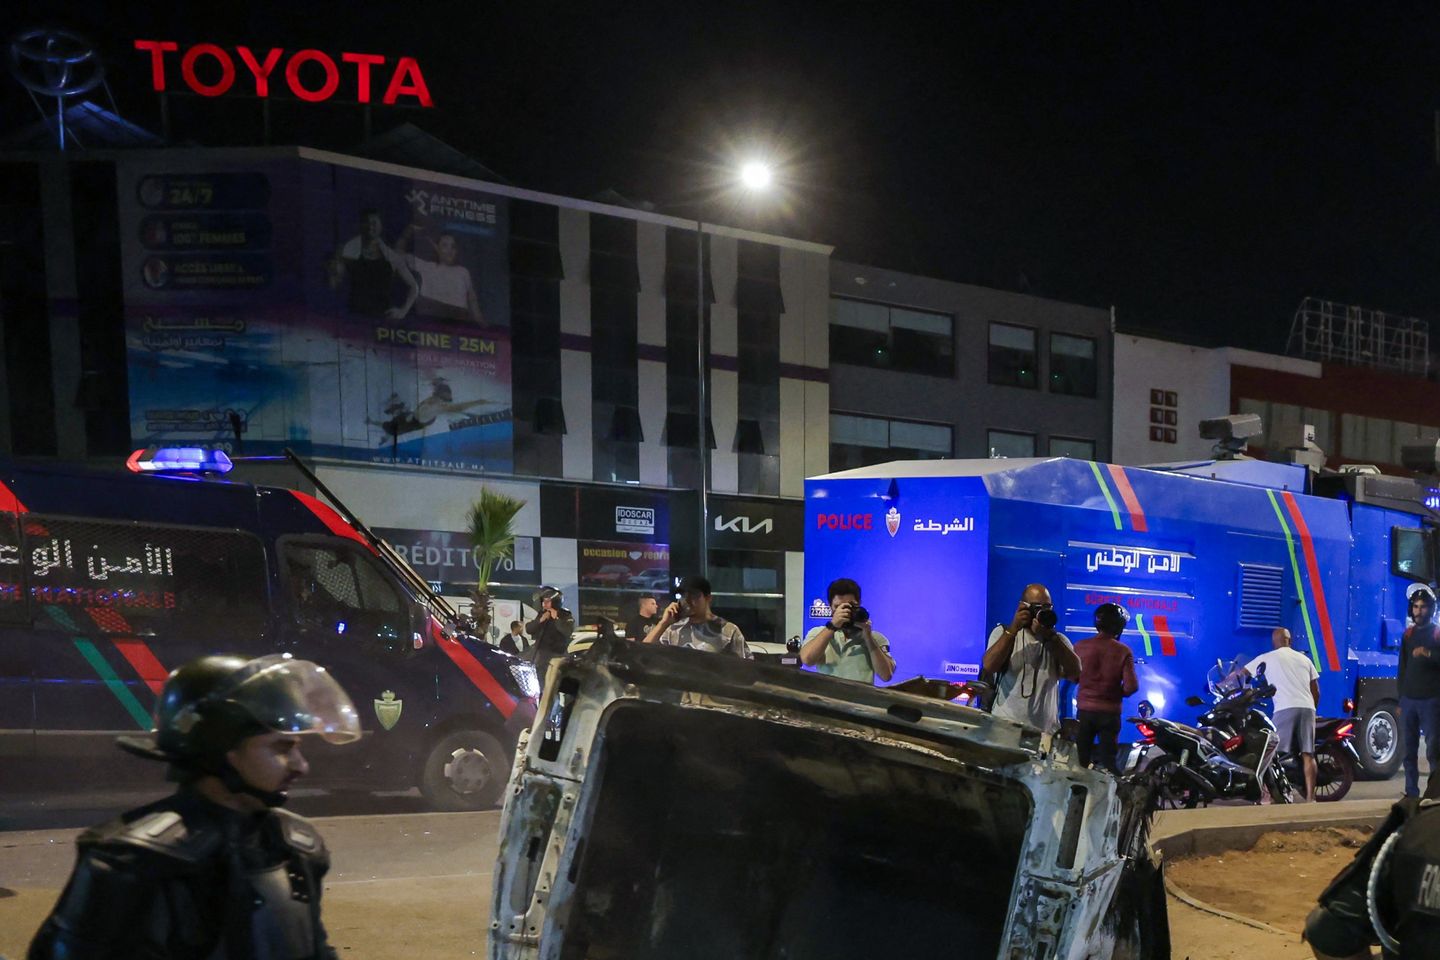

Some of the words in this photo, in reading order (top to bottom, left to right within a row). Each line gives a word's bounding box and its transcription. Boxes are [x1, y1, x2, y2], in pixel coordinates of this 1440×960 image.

[134, 39, 433, 108] TOYOTA
[431, 193, 496, 213] ANYTIME
[431, 205, 496, 224] FITNESS
[376, 327, 451, 349] PISCINE
[459, 336, 495, 355] 25M
[617, 509, 651, 519] IDOSCAR
[817, 514, 873, 530] POLICE
[715, 515, 773, 534] KIA
[913, 517, 974, 535] الشرطة
[88, 543, 174, 580] الأمن
[395, 540, 471, 568] RÉDIT
[1086, 547, 1140, 574] الوطني
